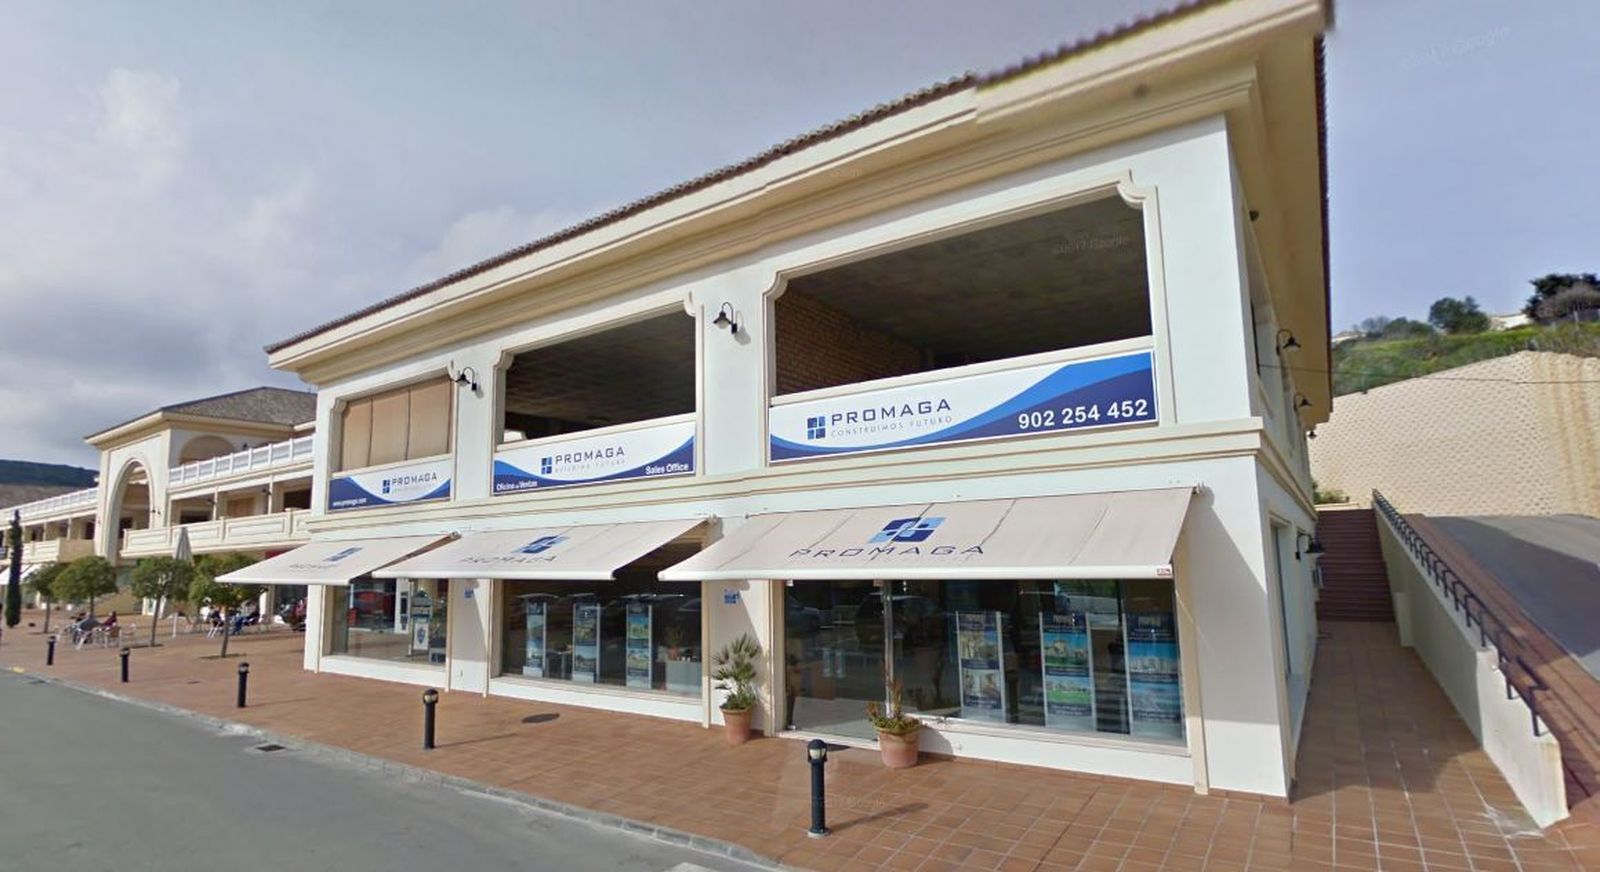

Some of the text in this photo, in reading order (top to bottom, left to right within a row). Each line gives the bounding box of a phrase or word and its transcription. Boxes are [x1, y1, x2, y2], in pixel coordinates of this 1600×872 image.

[831, 398, 951, 427] PROMAGA
[1018, 398, 1148, 429] 902 254 452
[831, 415, 953, 437] CONSTRUIMOS FUTURO
[555, 446, 625, 465] PROMAGA
[392, 471, 437, 486] PROMAGA
[645, 463, 689, 475] Sales Office
[788, 545, 984, 560] PROMAGA
